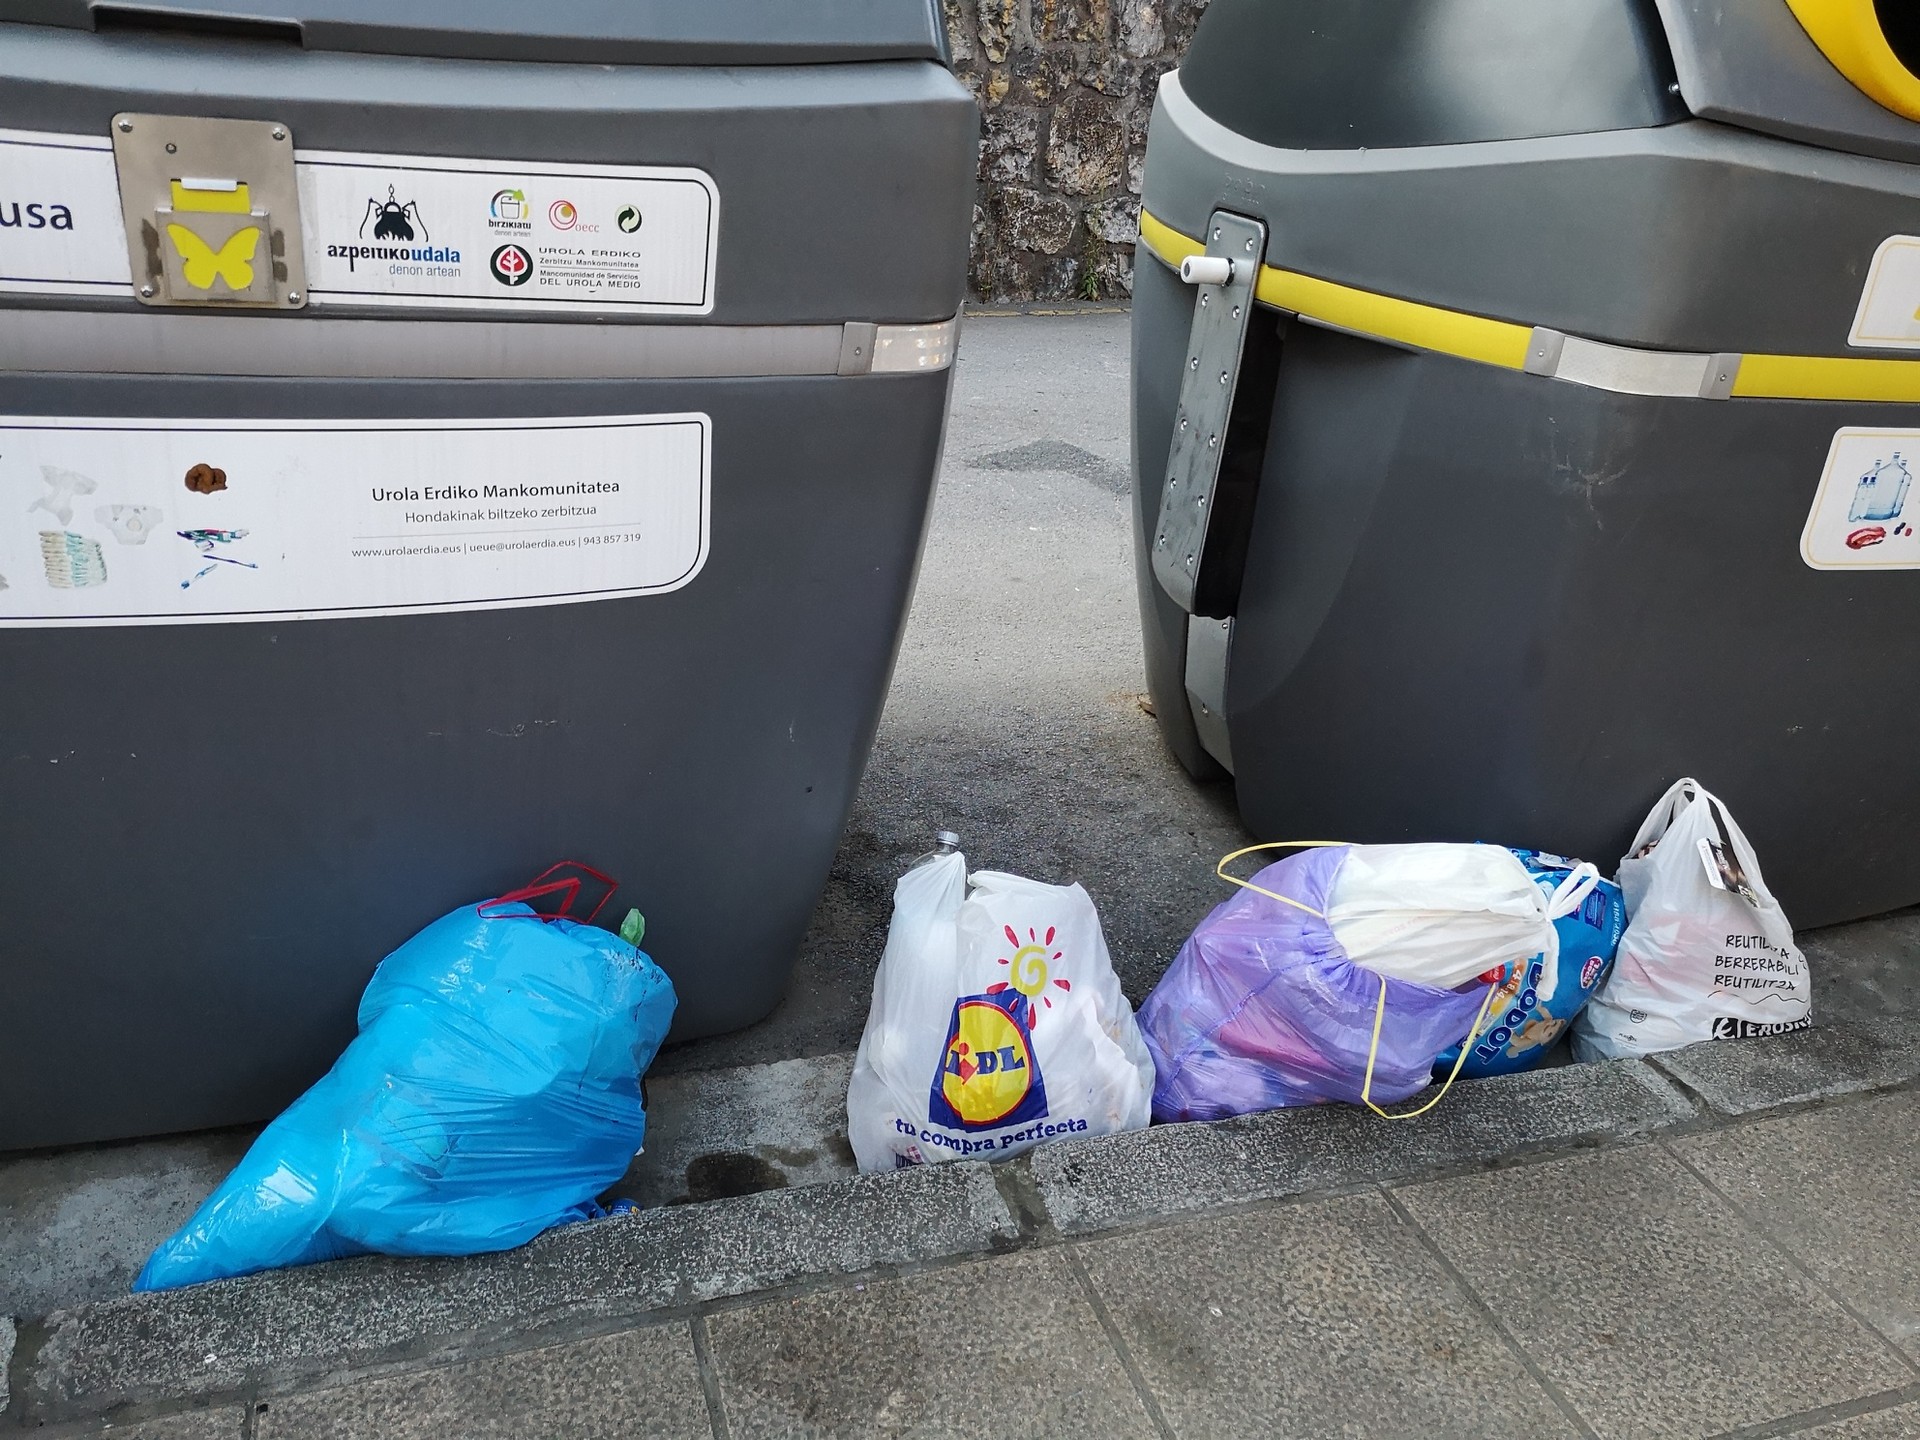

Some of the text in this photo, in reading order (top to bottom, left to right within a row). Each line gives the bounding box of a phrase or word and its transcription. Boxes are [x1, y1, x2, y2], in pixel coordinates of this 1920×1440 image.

[539, 247, 641, 259] UROLA ERDIKO
[389, 264, 461, 277] denon artean
[539, 257, 639, 268] Zerbitzu Mankomunitatea
[540, 269, 595, 279] Mancomunidad
[540, 278, 641, 289] DEL UROLA MEDIO
[372, 481, 620, 501] Urola Erdiko Mankomunitatea
[405, 505, 597, 524] Hondakinak biltzeko zerbitzua
[352, 533, 641, 557] www.urolaerdia.eus ueue@urolaerdia.eus 943 857 319
[1726, 934, 1790, 960] REUTILA
[895, 1118, 1088, 1155] tu compra perfecta
